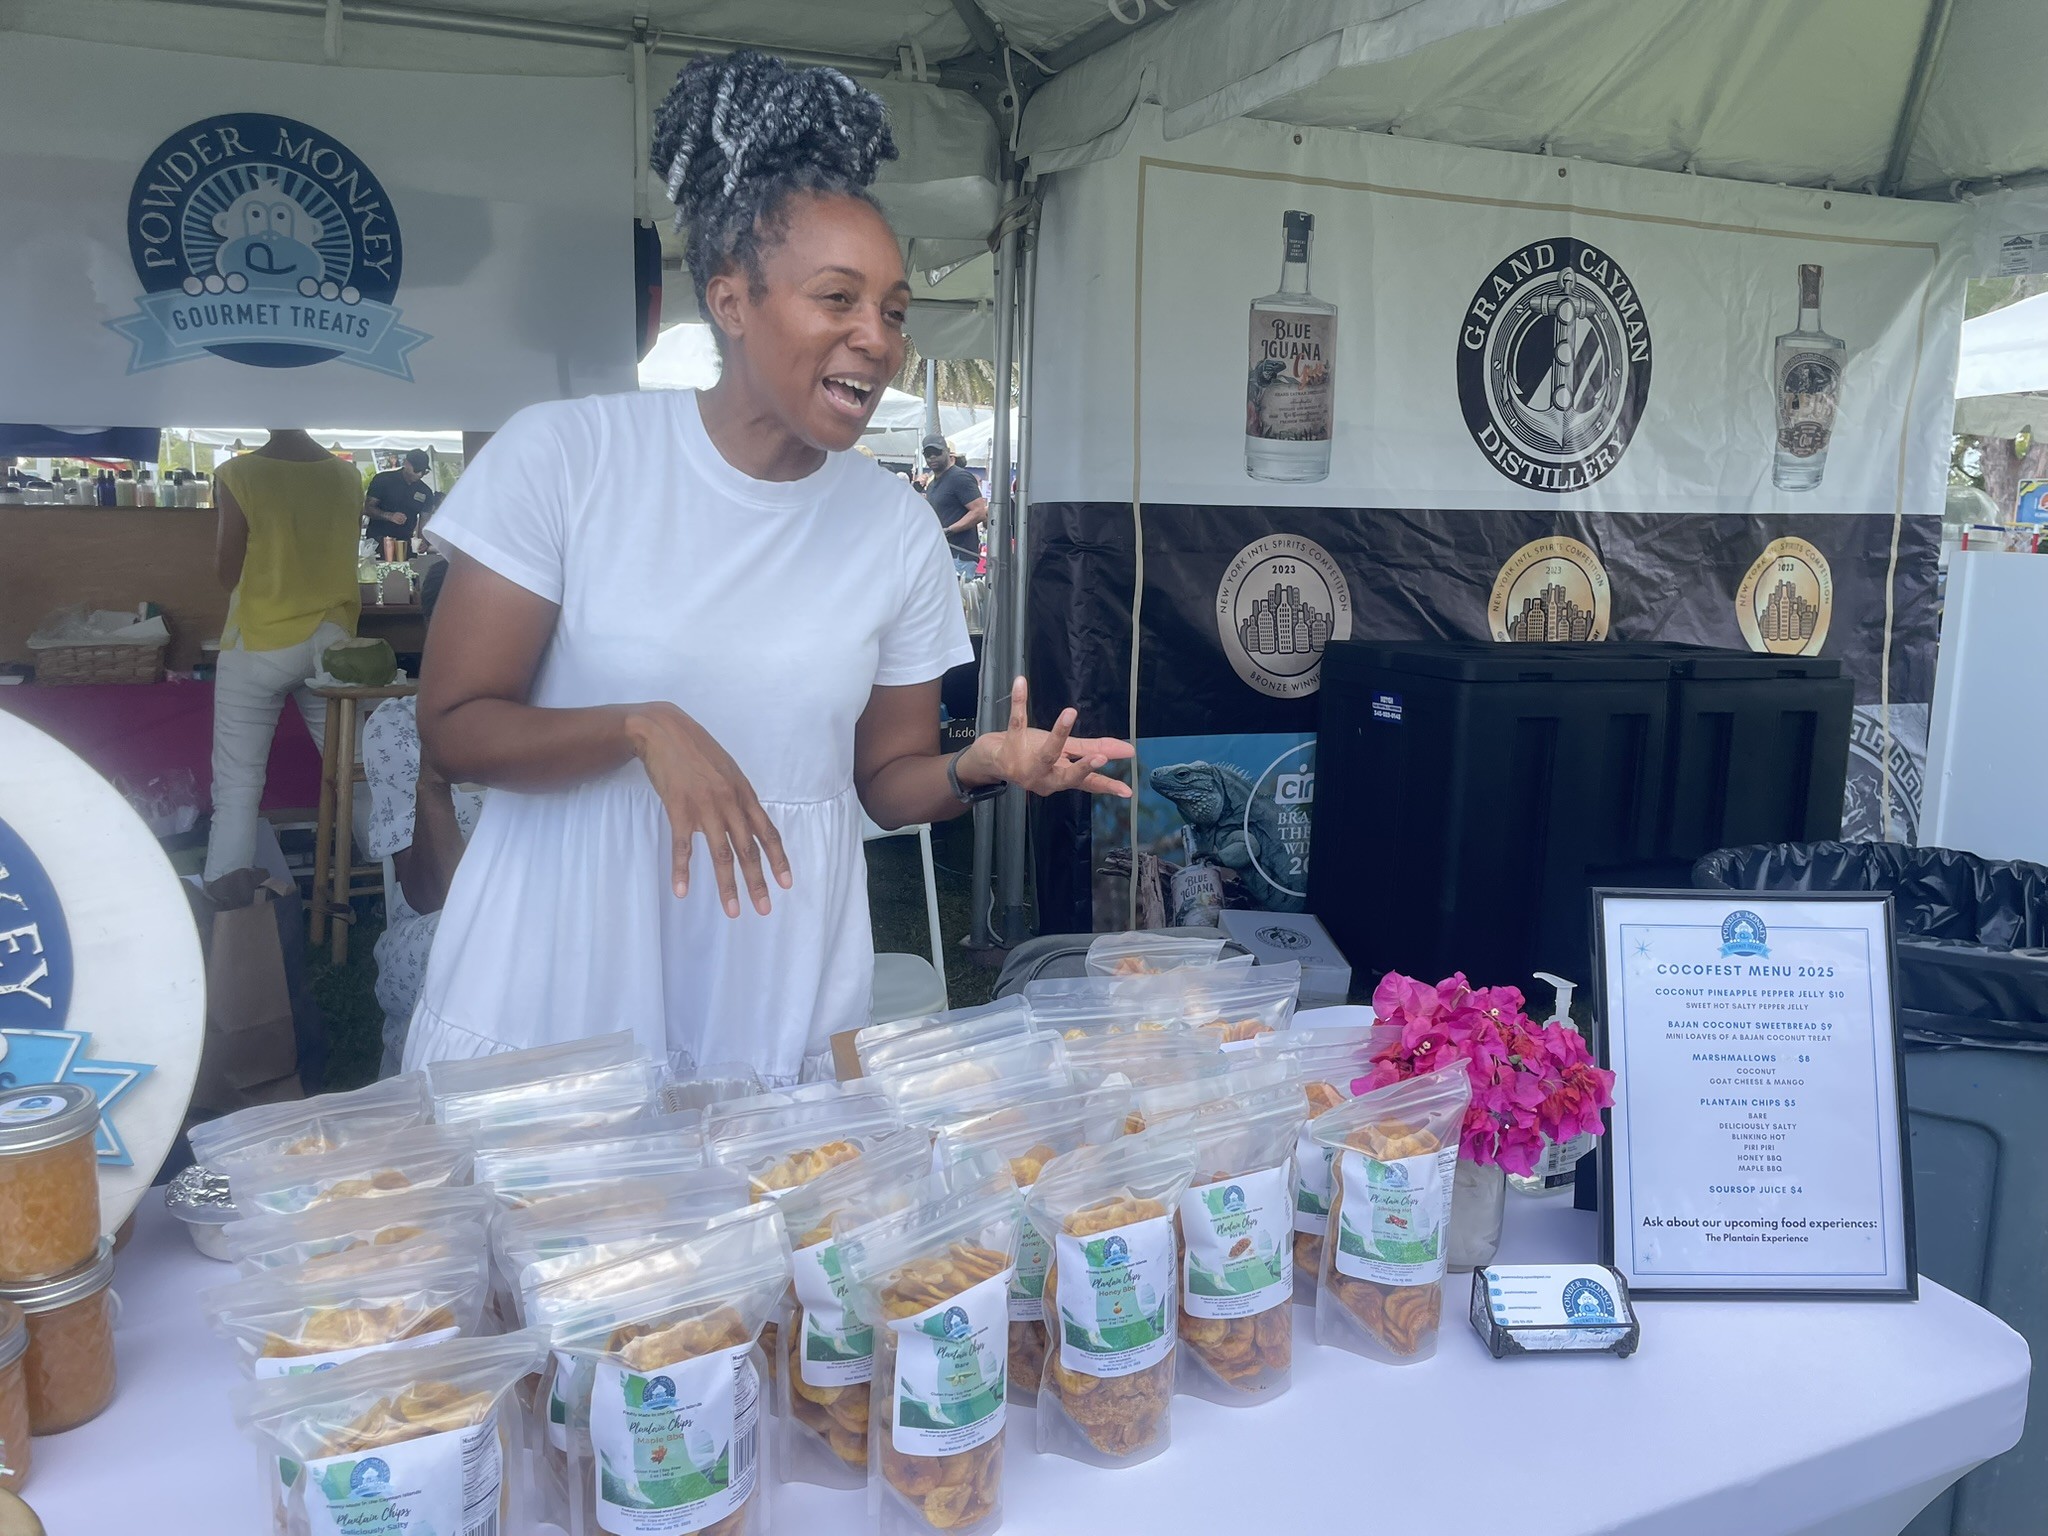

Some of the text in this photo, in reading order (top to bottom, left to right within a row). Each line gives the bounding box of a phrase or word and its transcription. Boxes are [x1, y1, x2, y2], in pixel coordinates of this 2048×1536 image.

[139, 127, 393, 281] POWDER MONKEY
[1463, 244, 1649, 363] GRAND CAYMAN
[172, 304, 370, 338] GOURMET TREATS
[1271, 318, 1311, 340] BLUE
[1261, 339, 1321, 361] IGUANA
[1476, 420, 1625, 490] DISTILLERY
[1272, 564, 1296, 574] 2023
[1545, 566, 1562, 575] 2023
[1220, 540, 1348, 614] NEW YORK INTL SPIRITS COMPETITION
[1492, 592, 1502, 612] NEW
[1499, 566, 1516, 589] YORK
[1515, 551, 1532, 567] INTL
[1565, 544, 1604, 587] COMPETITION
[1740, 585, 1749, 607] NEW
[1748, 557, 1767, 580] YORK
[1805, 549, 1829, 605] COMPETITION
[1250, 670, 1287, 692] BRONZE
[1185, 873, 1208, 887] BLUE
[1180, 882, 1214, 900] IGUANA
[1657, 964, 1834, 977] COCOFEST MENU 2025
[1655, 988, 1845, 999] COCONUT PINEAPPLE PEPPER JELLY $10
[1713, 1002, 1729, 1010] HOT
[1732, 1002, 1757, 1010] SALTY
[1787, 1003, 1809, 1011] JELLY
[1668, 1021, 1833, 1031] BAJAN COCONUT SWEETBREAD $9
[1766, 1034, 1806, 1042] COCONUT
[1692, 1054, 1810, 1063] MARSHMALLOWS $8
[1709, 1078, 1732, 1086] GOAT
[1700, 1098, 1796, 1108] PLANTAIN CHIPS $5
[1731, 1133, 1768, 1141] BLINKING
[1709, 1185, 1803, 1195] SOURSOP JUICE $4
[1642, 1216, 1878, 1232] Ask about our upcoming food experiences:
[1705, 1233, 1809, 1244] The Plantain Experience
[1091, 1269, 1141, 1289] Plantain Chips
[1099, 1289, 1121, 1297] Honey
[1564, 1280, 1614, 1313] POWDER MONKEY
[629, 1414, 694, 1435] Plantain Chips
[637, 1436, 664, 1444] Maple
[336, 1502, 412, 1527] Plantain Chips
[340, 1521, 409, 1535] Deliciously Salty
